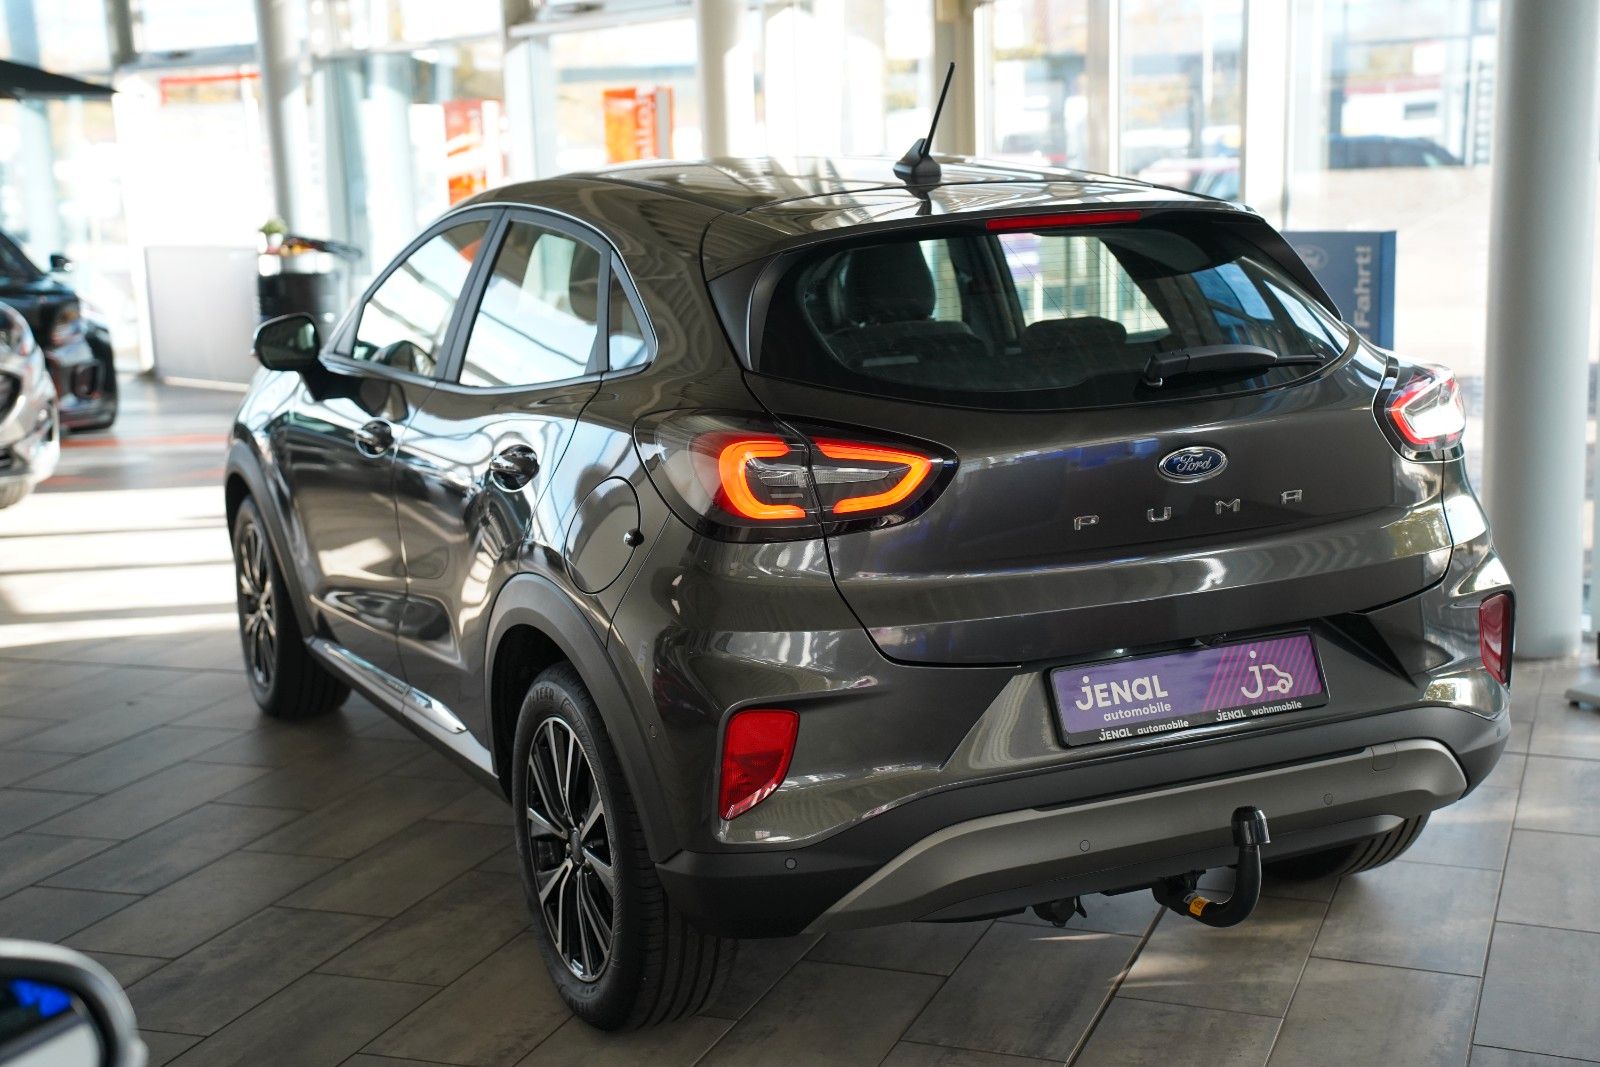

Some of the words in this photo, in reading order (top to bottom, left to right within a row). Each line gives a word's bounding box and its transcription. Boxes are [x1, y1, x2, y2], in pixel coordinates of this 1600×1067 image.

[1176, 452, 1212, 472] Ford
[1074, 489, 1302, 531] PUMA
[1103, 702, 1172, 722] automobile
[1250, 700, 1302, 716] wohnmobile
[1137, 719, 1189, 735] automobile
